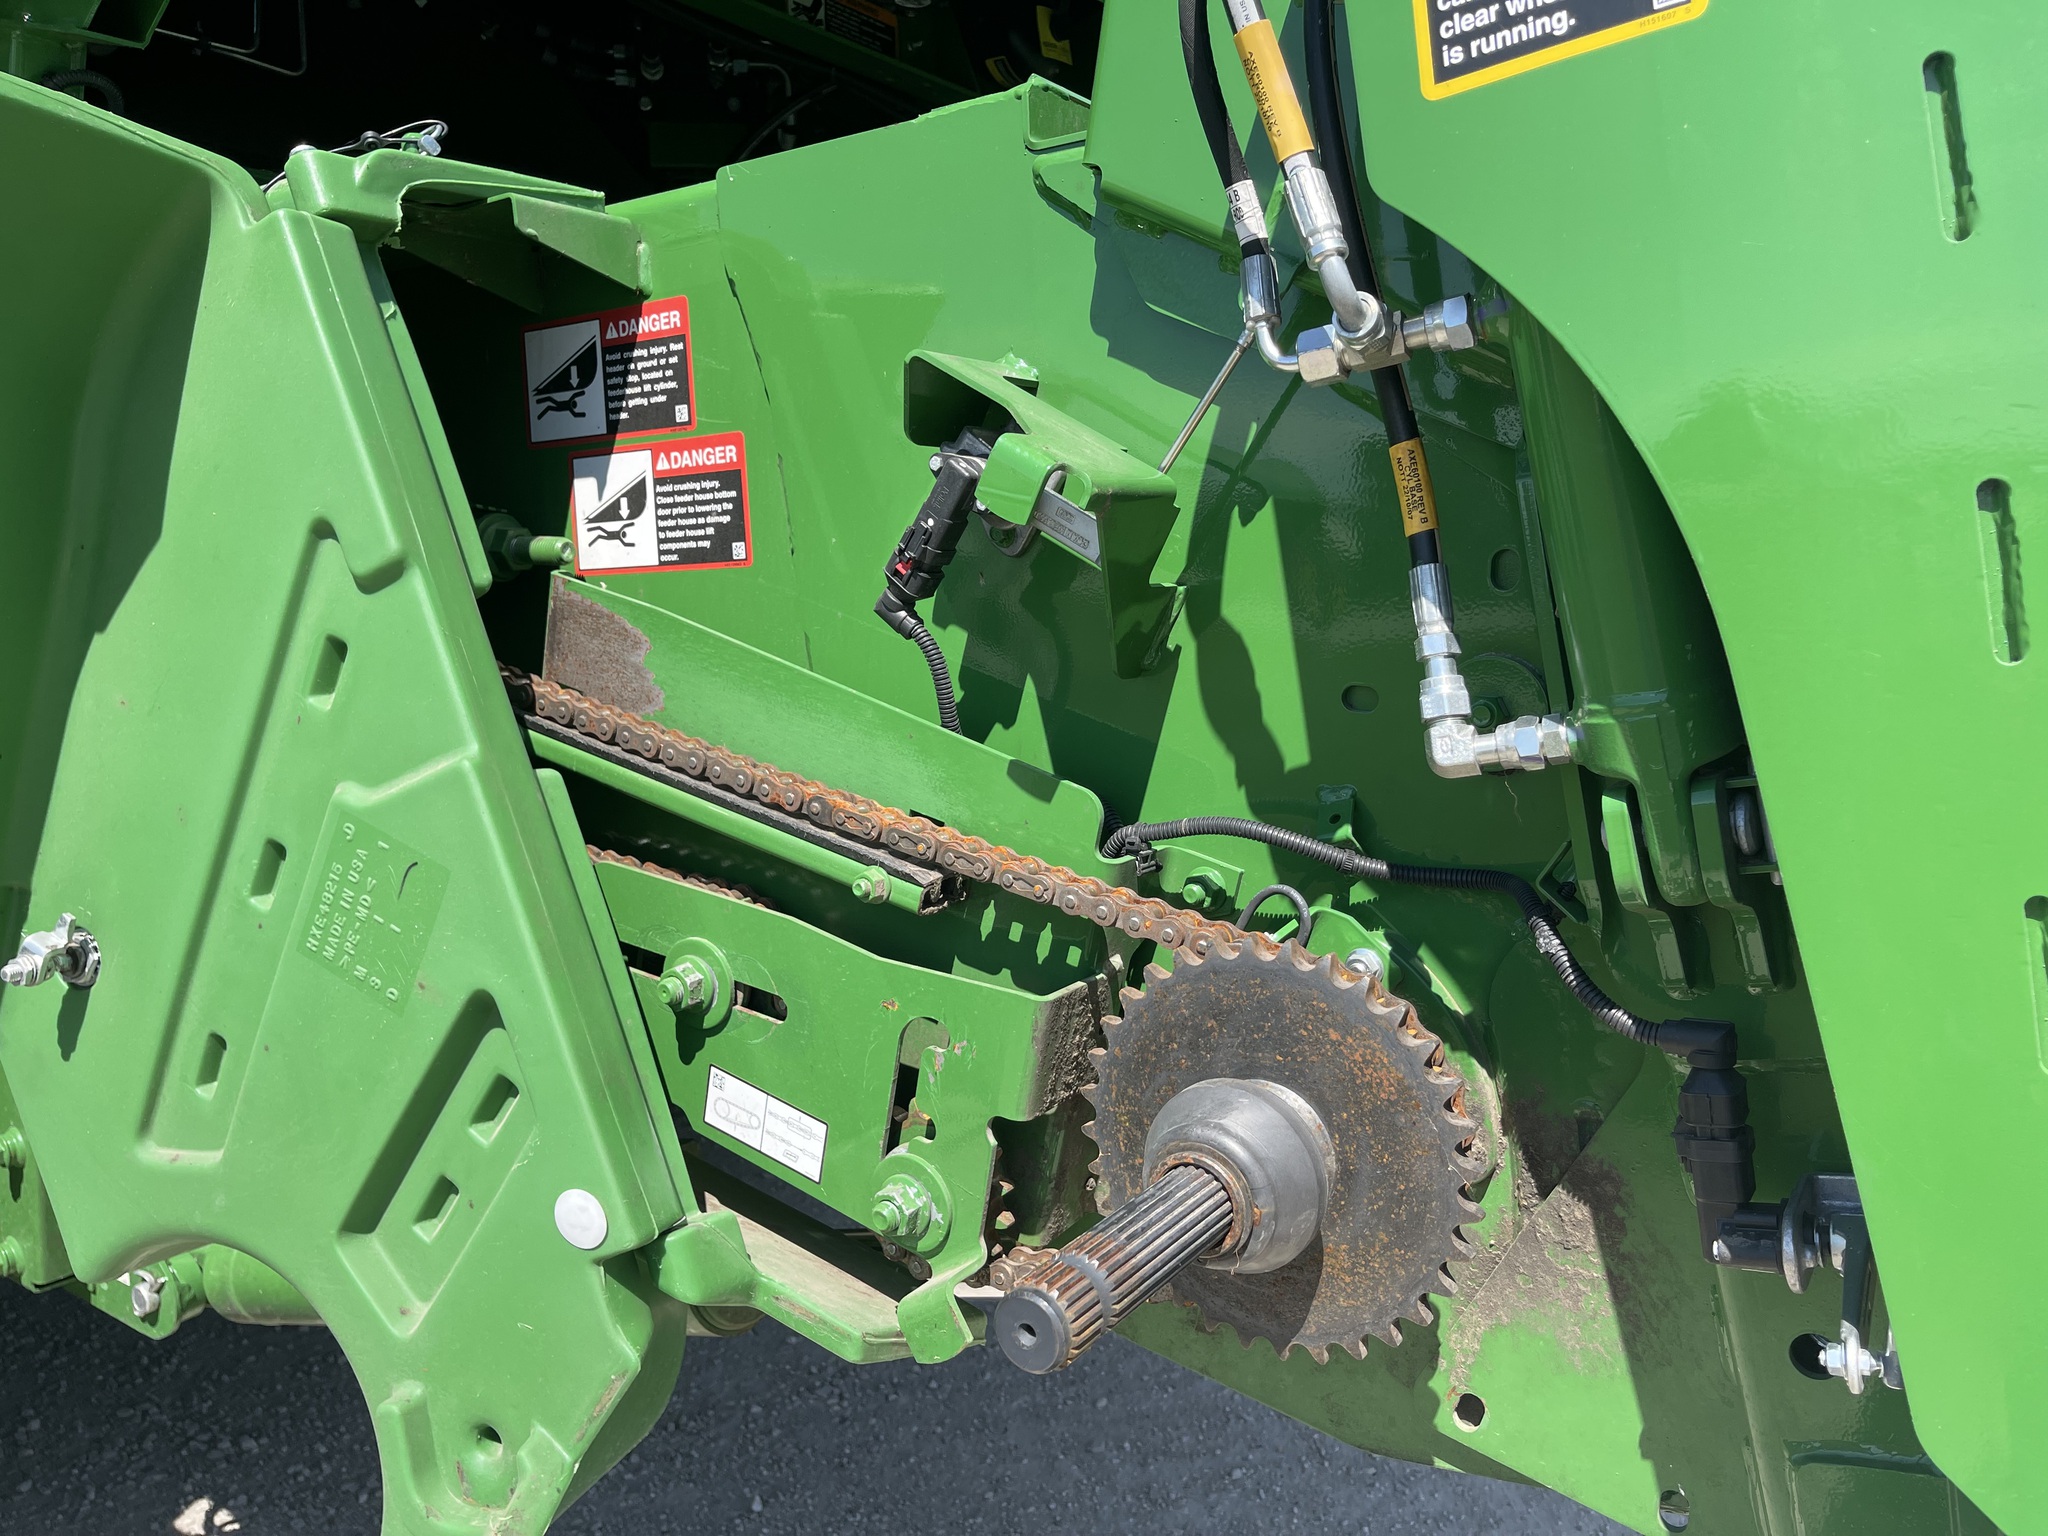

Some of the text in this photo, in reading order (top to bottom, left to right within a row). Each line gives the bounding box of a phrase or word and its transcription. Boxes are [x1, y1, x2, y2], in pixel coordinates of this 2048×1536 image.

[1440, 4, 1499, 38] clear
[1442, 10, 1575, 67] is running.
[618, 310, 681, 337] DANGER
[606, 342, 684, 361] Avoid crushing injury. Rest
[606, 364, 625, 373] header
[637, 359, 657, 370] ground
[668, 355, 678, 364] set
[607, 377, 623, 385] safety
[626, 374, 640, 383] stop,
[642, 369, 663, 380] located
[643, 384, 652, 392] lift
[654, 381, 678, 392] cylinder,
[628, 397, 648, 408] getting
[650, 395, 667, 403] under
[609, 412, 629, 420] header.
[670, 445, 737, 469] DANGER
[1396, 458, 1405, 482] NOTT
[656, 480, 720, 493] Avoid crushing injury.
[1404, 466, 1418, 511] CYL BASE
[1407, 449, 1422, 493] AXE60100
[1417, 496, 1426, 514] REV
[656, 496, 673, 504] Close
[674, 494, 693, 502] feeder
[714, 491, 736, 499] bottom
[657, 508, 671, 516] door
[672, 506, 687, 516] prior
[695, 503, 721, 512] lowering
[722, 502, 733, 510] the
[658, 518, 677, 527] feeder
[706, 515, 731, 524] damage
[666, 530, 685, 538] feeder
[706, 527, 714, 535] lift
[660, 540, 710, 551] components may
[306, 862, 342, 952] HXE48215
[322, 849, 368, 961] MADE IN USA
[354, 965, 368, 981] M
[369, 977, 382, 990] S
[386, 988, 398, 1001] D
